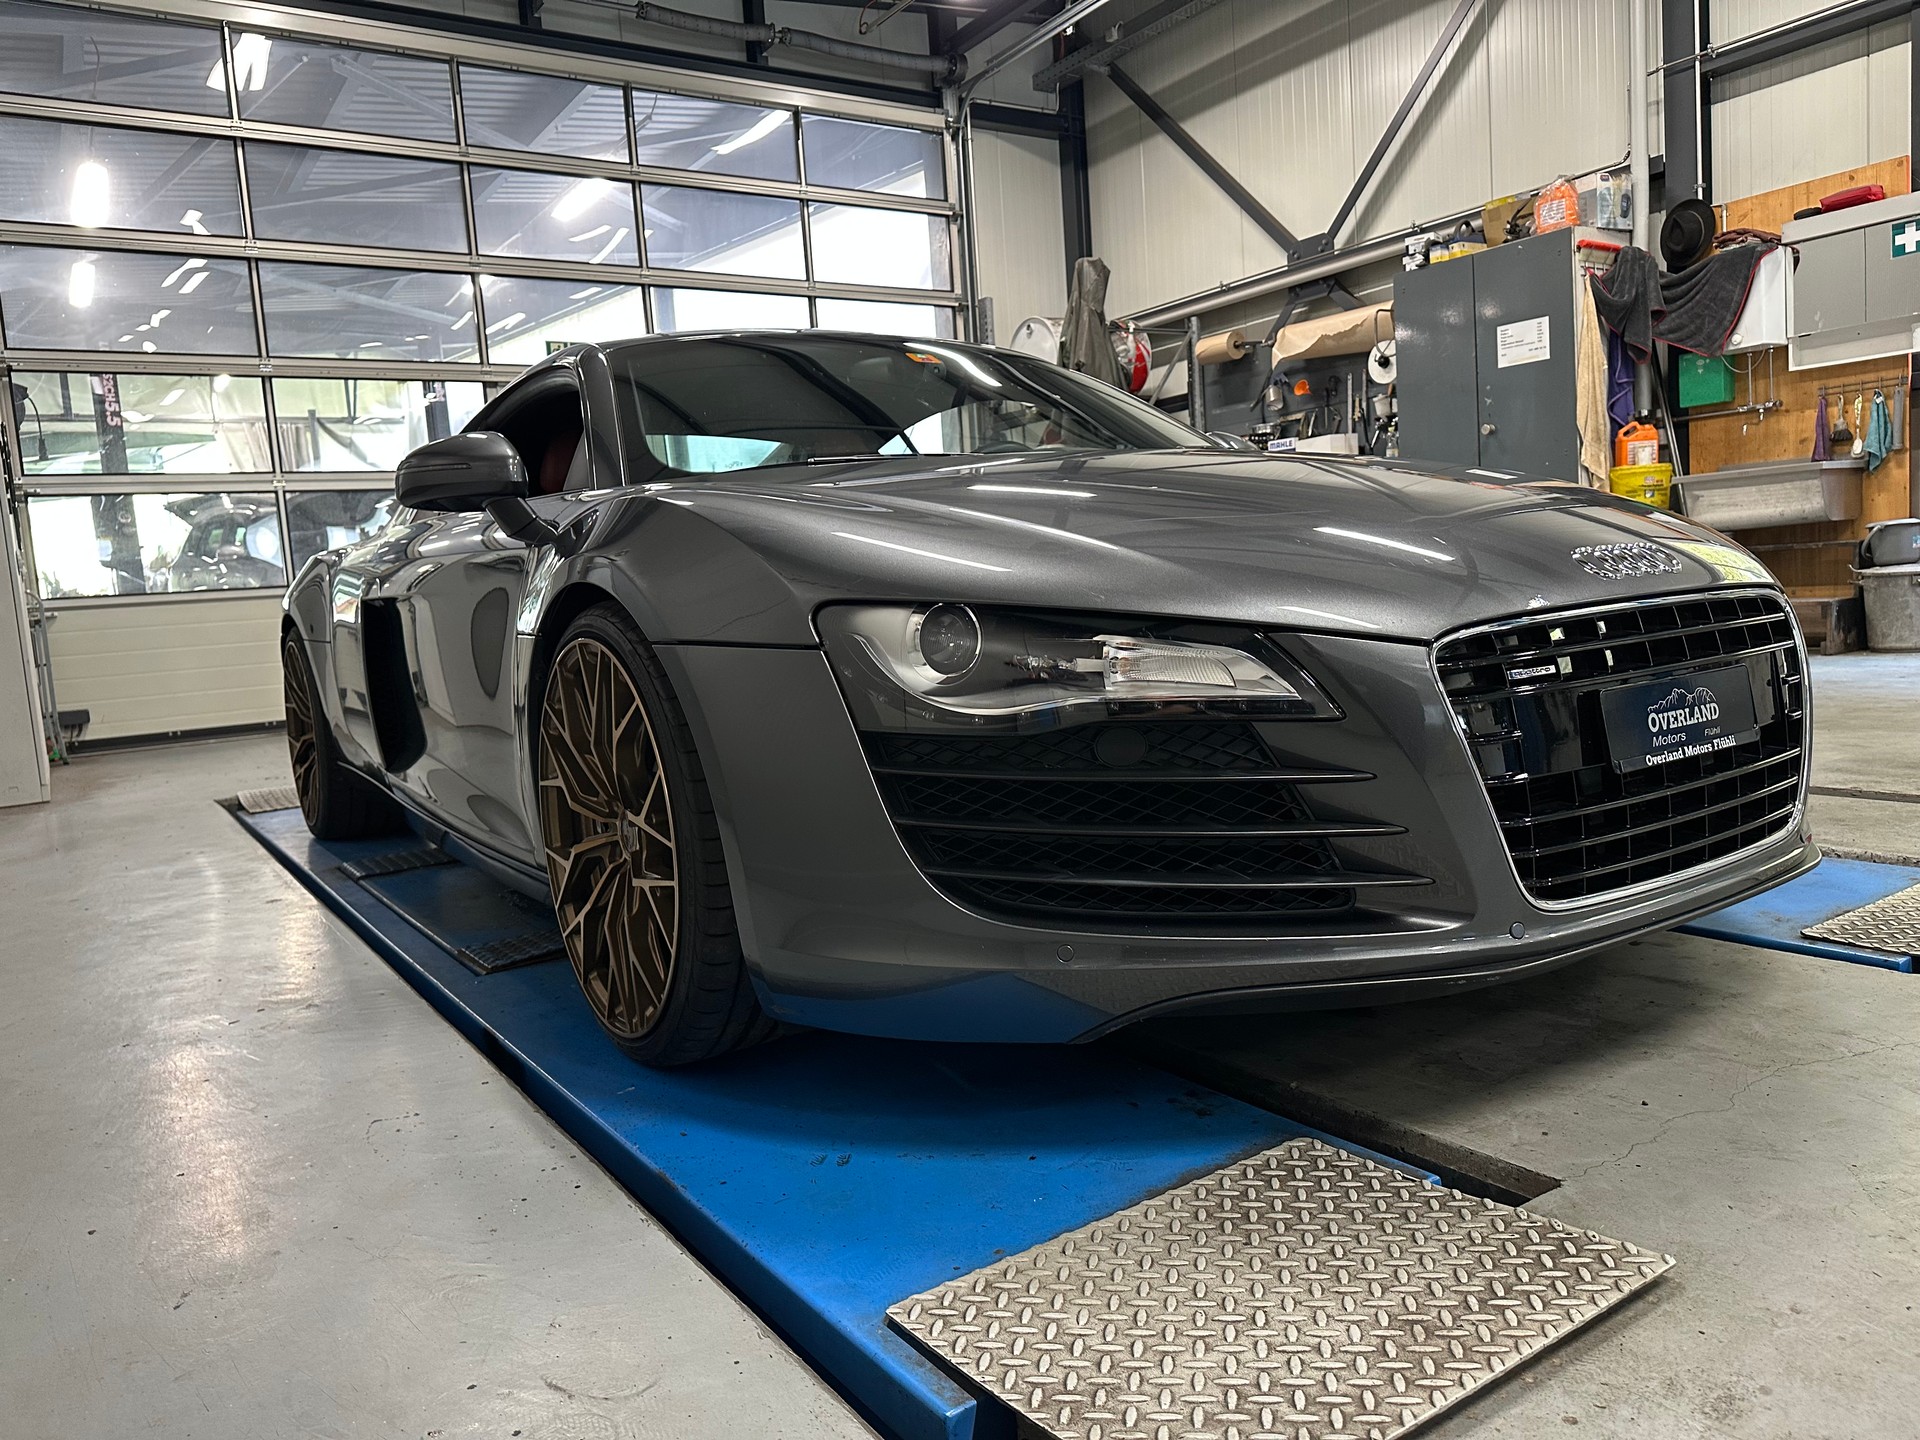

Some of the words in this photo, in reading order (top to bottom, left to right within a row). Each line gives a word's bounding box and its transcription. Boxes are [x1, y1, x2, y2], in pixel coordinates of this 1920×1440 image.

[1269, 440, 1293, 450] MAHLE
[1647, 702, 1720, 733] OVERLAND
[1645, 747, 1684, 766] Overland
[1684, 743, 1713, 758] Motors
[1713, 735, 1737, 751] Flühli
[1652, 732, 1687, 748] Motors
